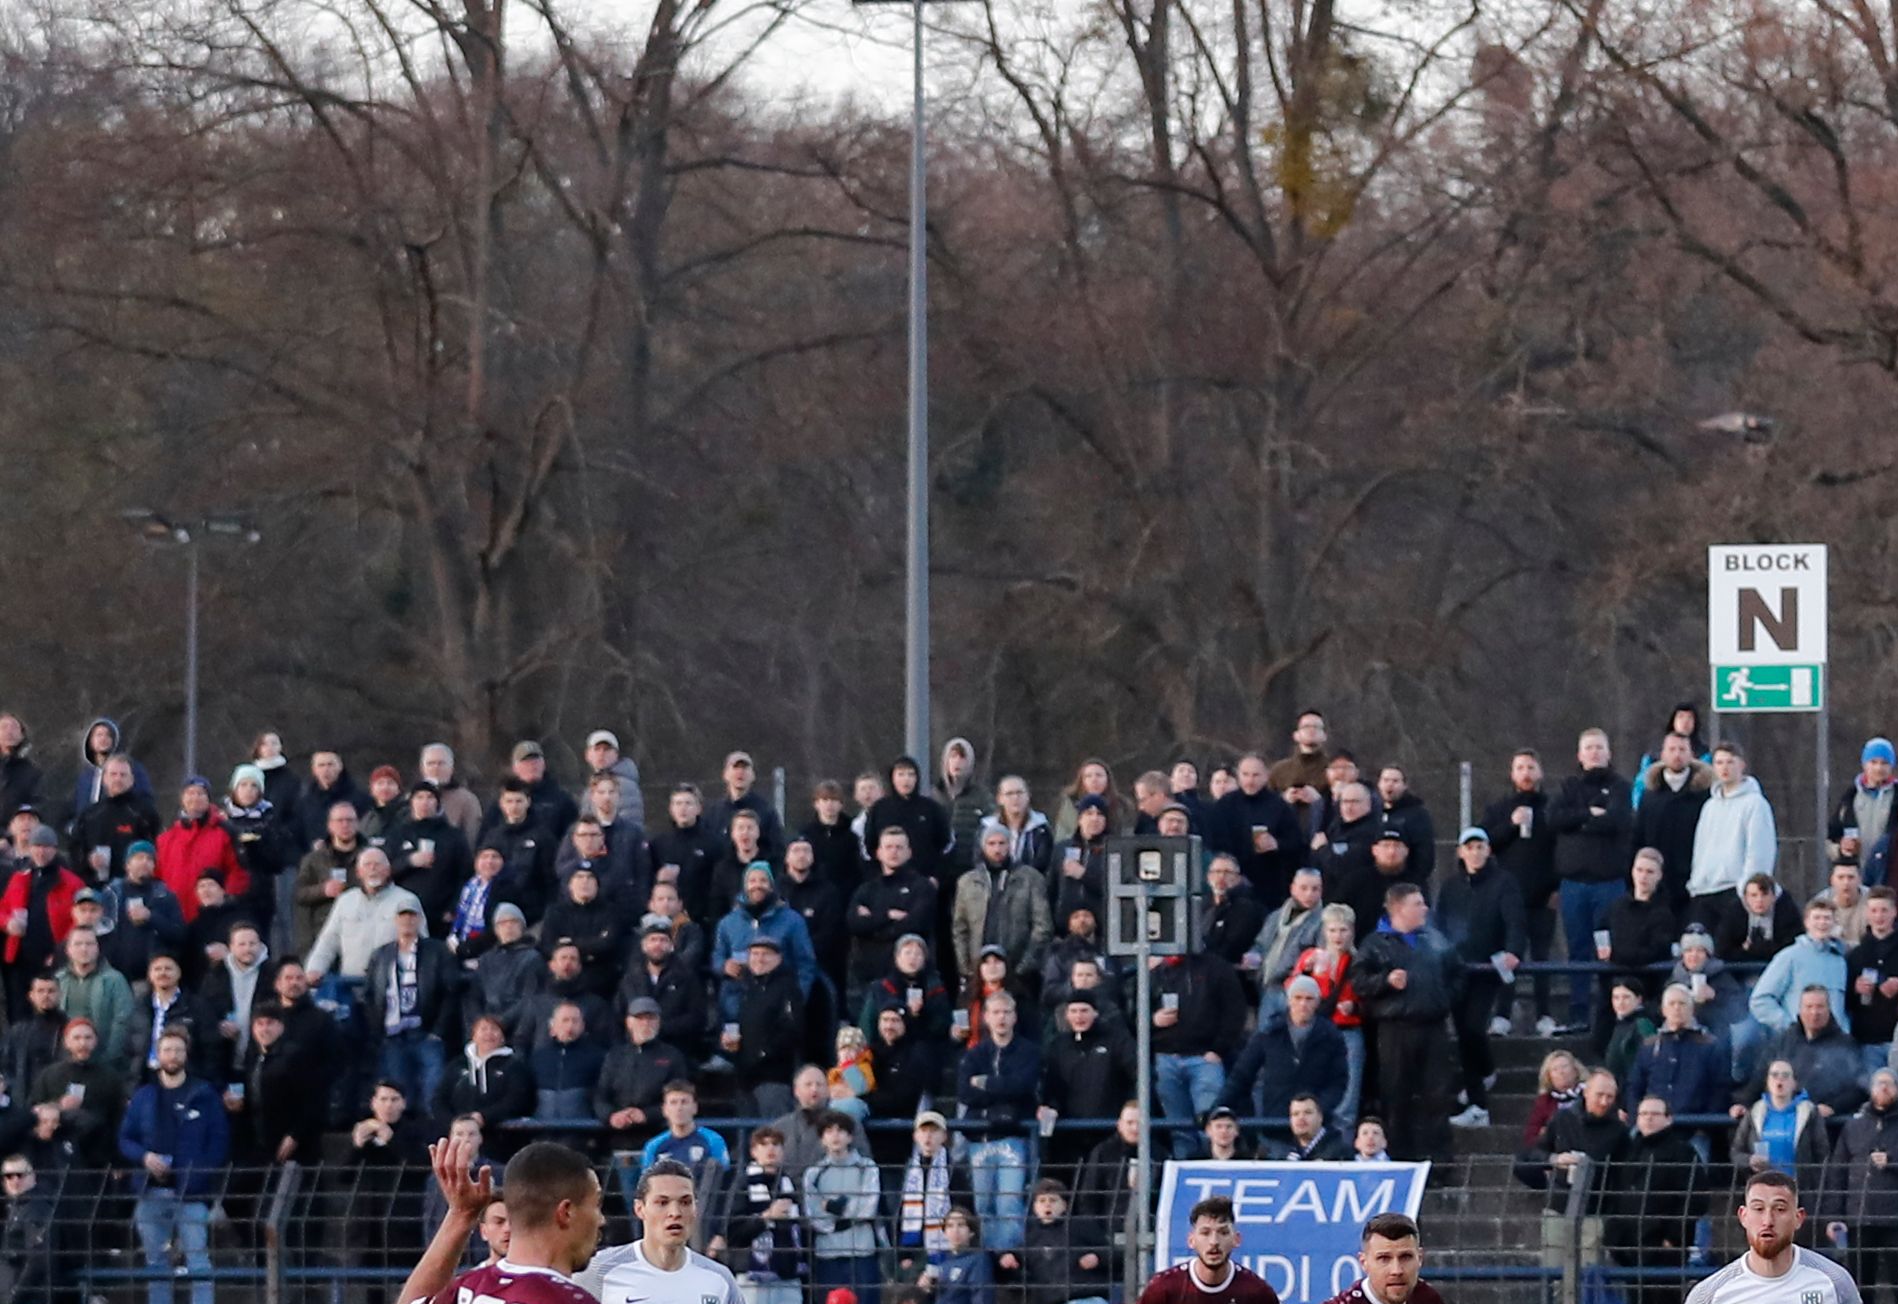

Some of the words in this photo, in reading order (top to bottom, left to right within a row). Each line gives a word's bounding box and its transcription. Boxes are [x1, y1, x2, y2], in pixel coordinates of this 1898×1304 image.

[1725, 553, 1810, 571] BLOCK
[1738, 587, 1799, 652] N
[1185, 1178, 1395, 1224] TEAM
